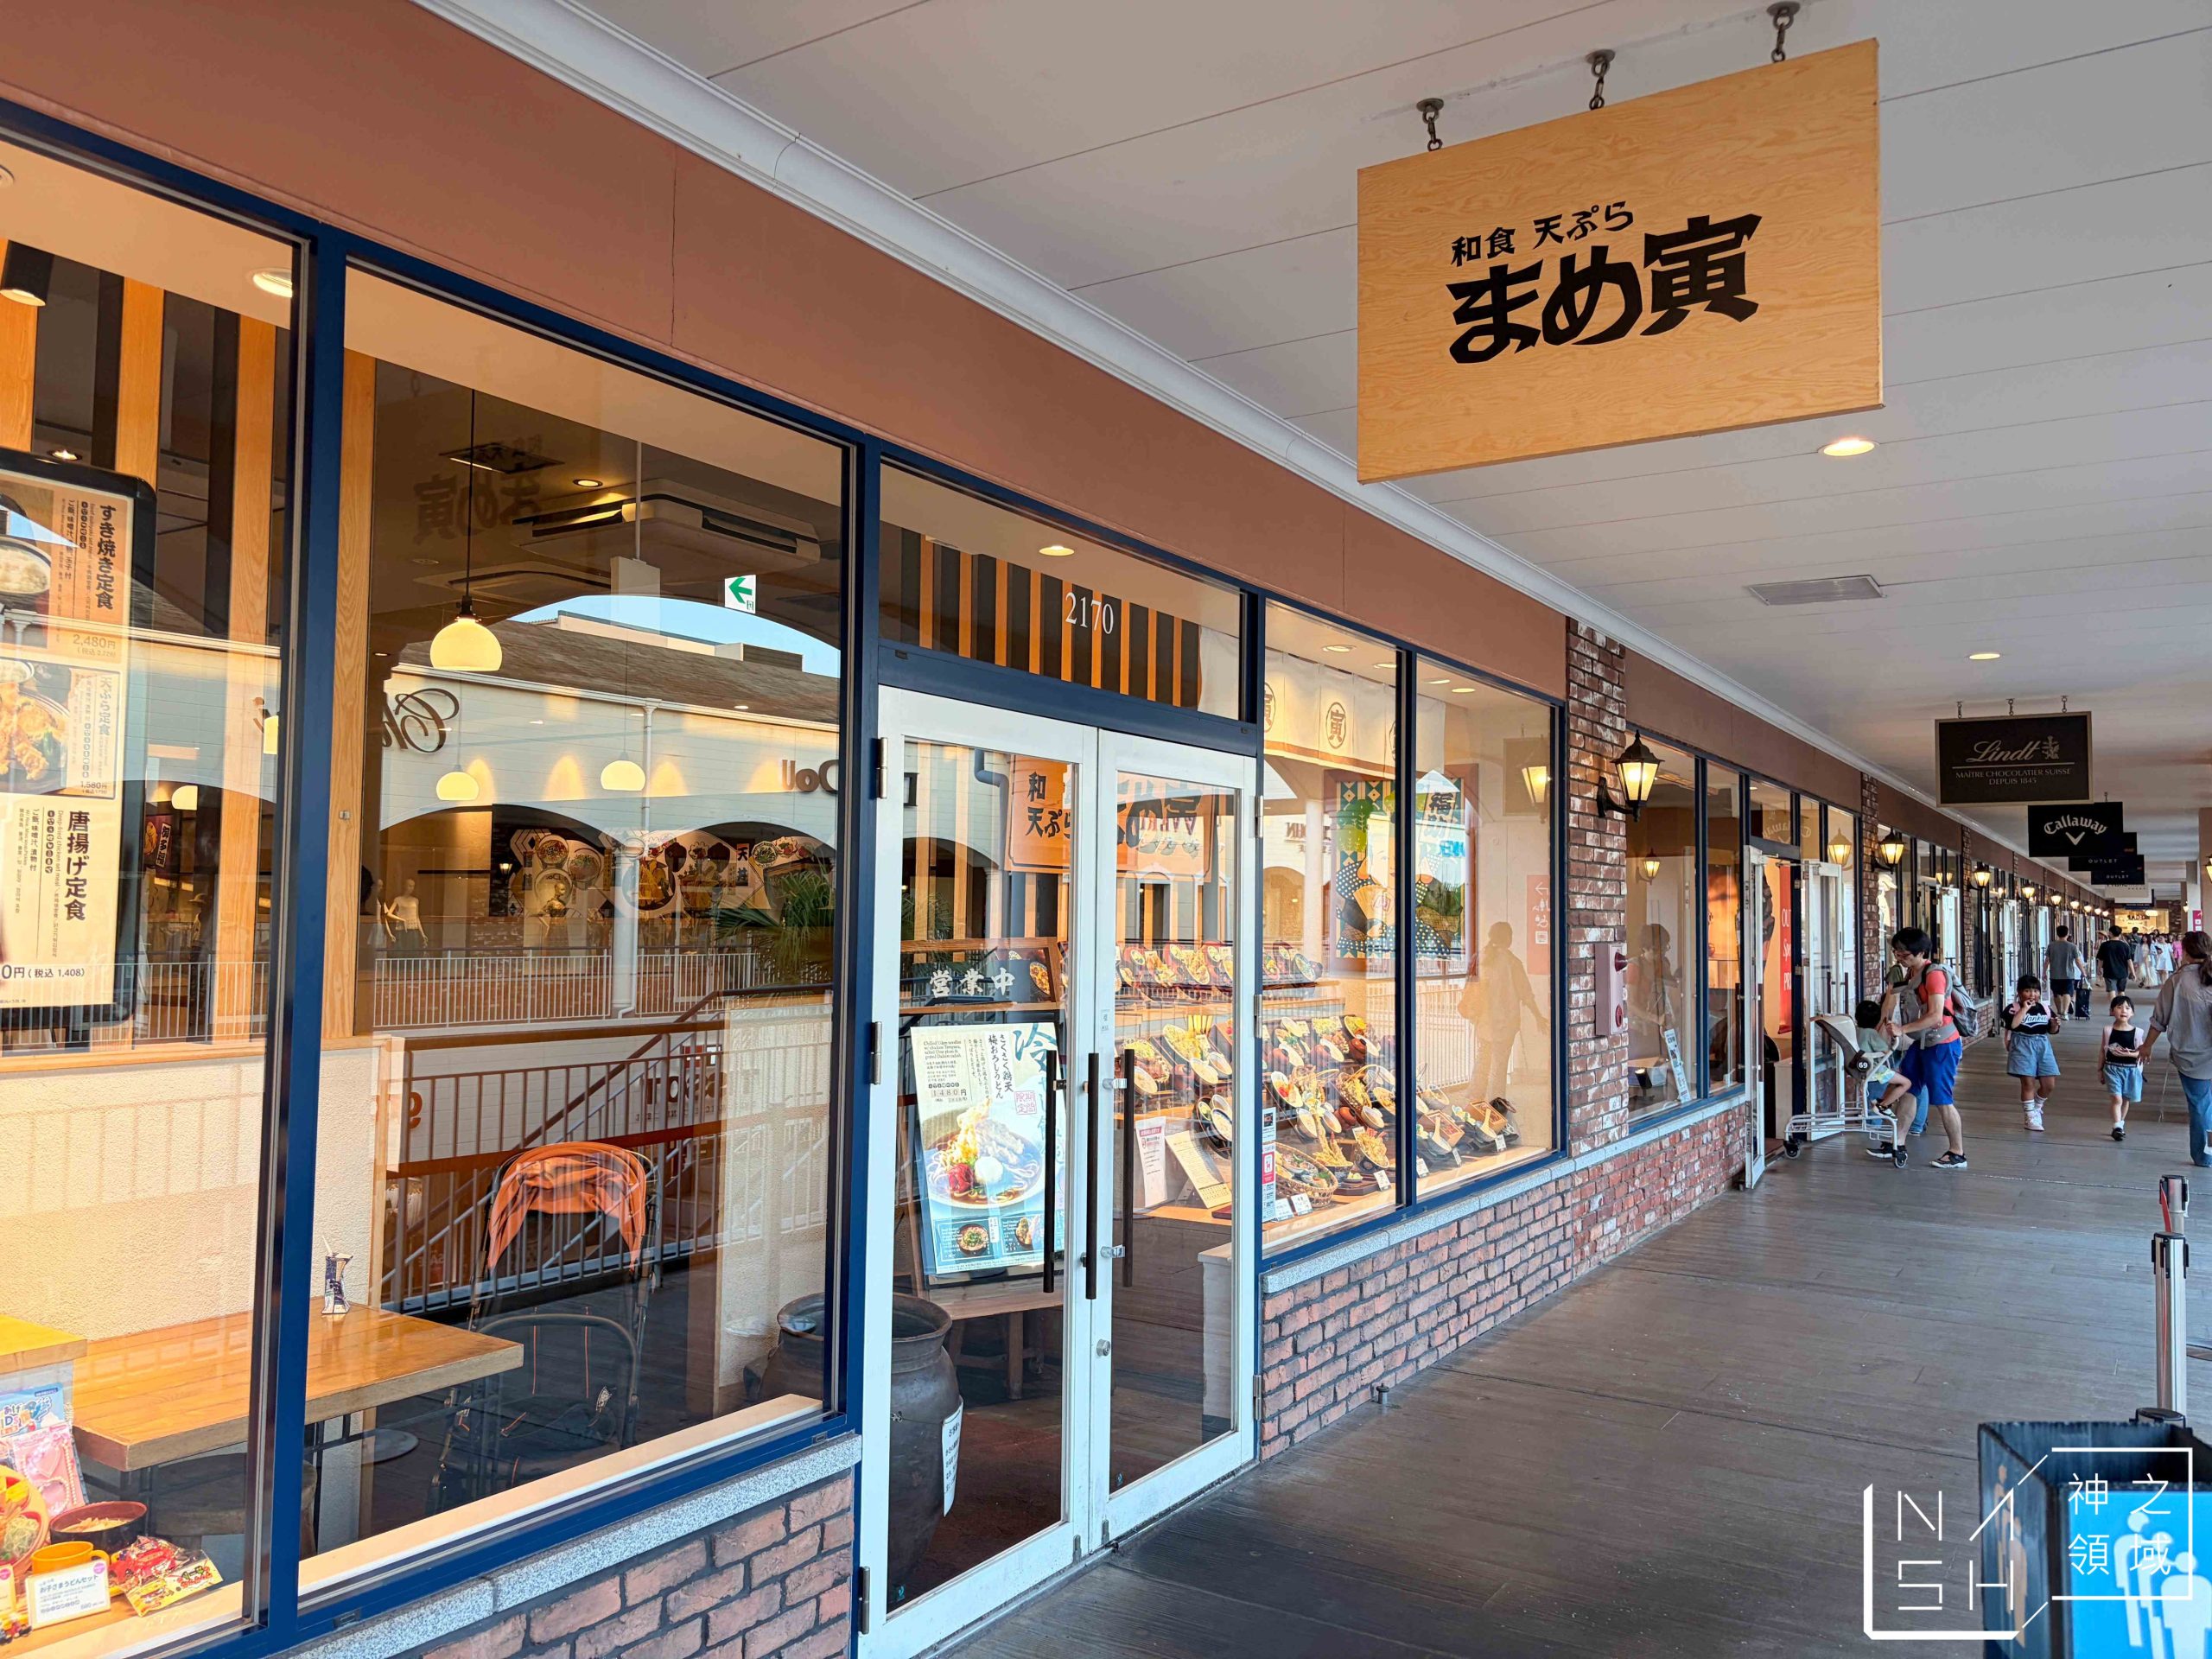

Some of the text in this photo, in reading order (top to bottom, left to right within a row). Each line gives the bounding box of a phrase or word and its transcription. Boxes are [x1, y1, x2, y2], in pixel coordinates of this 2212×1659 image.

[1451, 200, 1634, 267] 和食 天ぷら
[1446, 213, 1763, 364] まめ寅
[95, 505, 117, 610] すき焼き定食
[1065, 592, 1114, 634] 2170
[73, 633, 116, 649] 2,480円
[1329, 709, 1345, 742] 寅
[1966, 741, 2040, 762] Lindt
[1986, 768, 2043, 778] CHOCOLATIER
[2044, 767, 2071, 776] SUISSE
[2044, 814, 2107, 835] Callaway
[64, 810, 90, 921] 唐揚げ定食
[58, 968, 86, 977] 1,408)
[930, 967, 1015, 998] 営業中
[988, 1034, 1002, 1099] 梅おろしうどん
